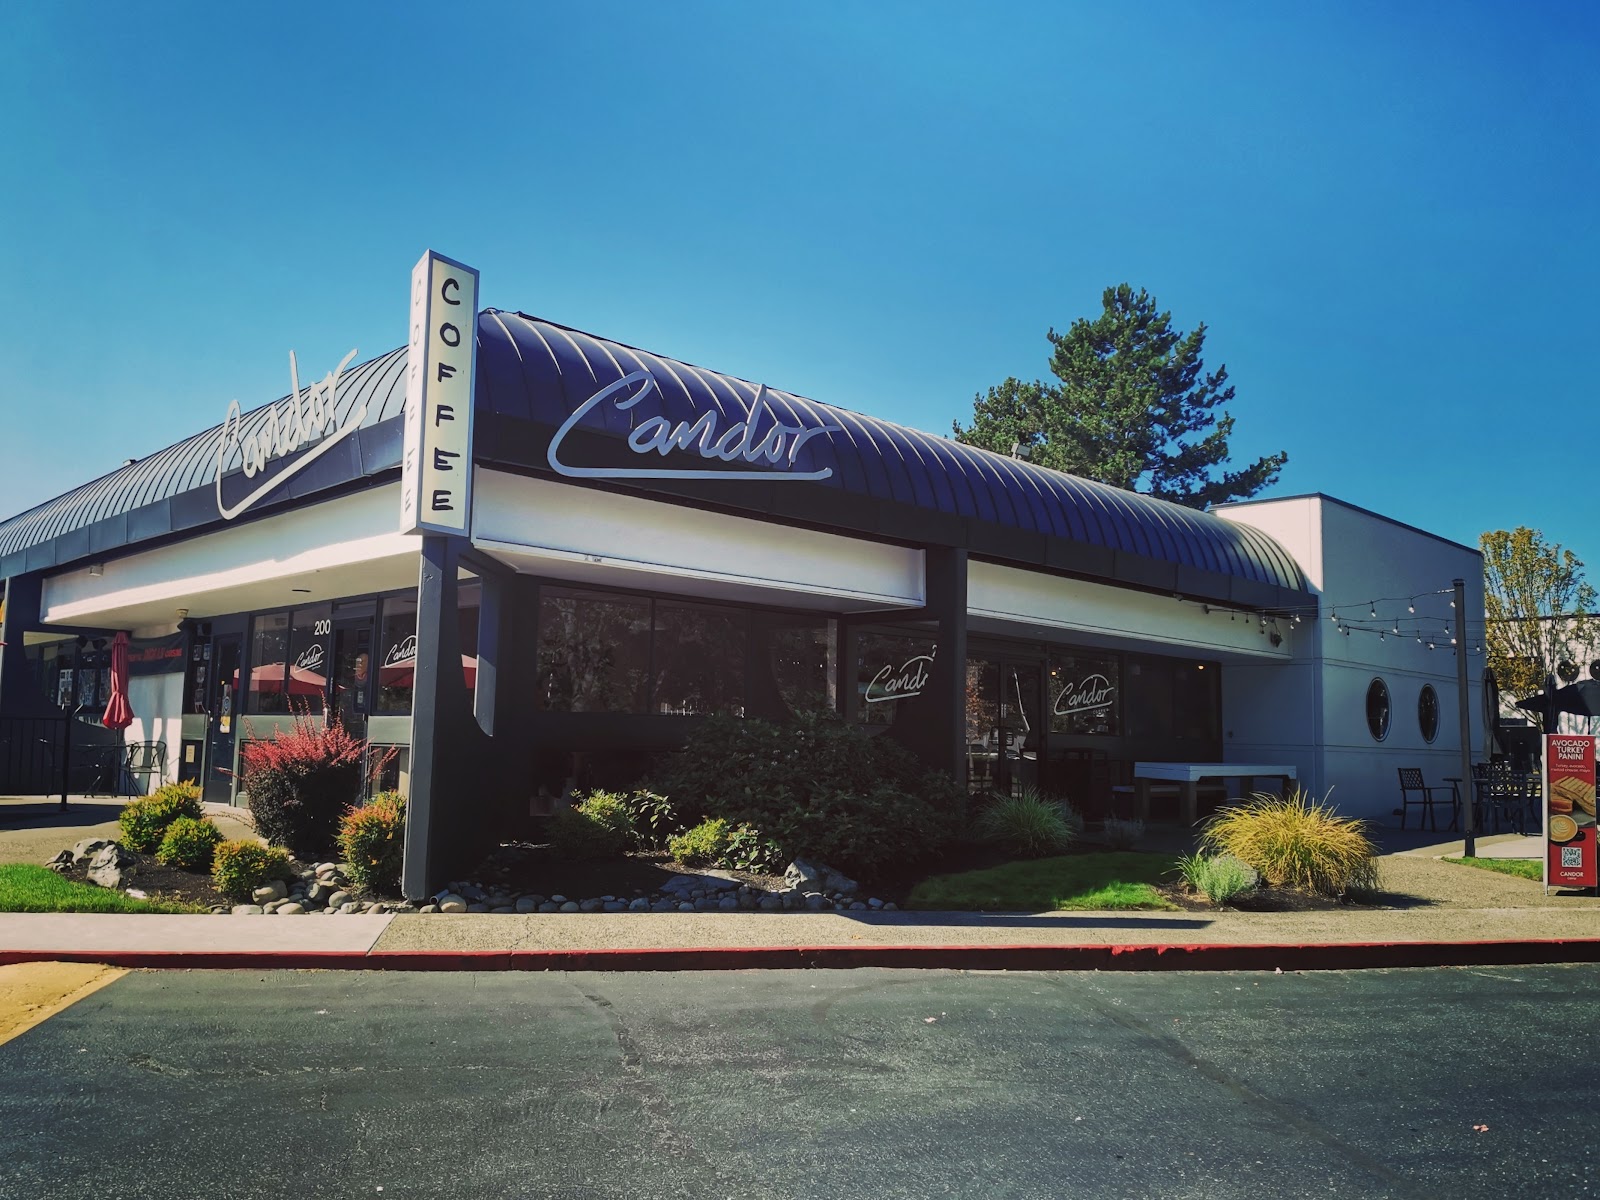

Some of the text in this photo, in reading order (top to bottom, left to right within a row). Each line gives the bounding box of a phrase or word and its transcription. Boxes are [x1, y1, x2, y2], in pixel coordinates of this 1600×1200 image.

[432, 277, 461, 511] COFFEE
[216, 348, 368, 520] Candor
[547, 370, 841, 480] Candor
[314, 619, 331, 636] 200
[294, 644, 325, 674] Candor
[385, 635, 417, 668] Cando
[865, 657, 931, 702] Cand
[1054, 674, 1114, 715] Candor
